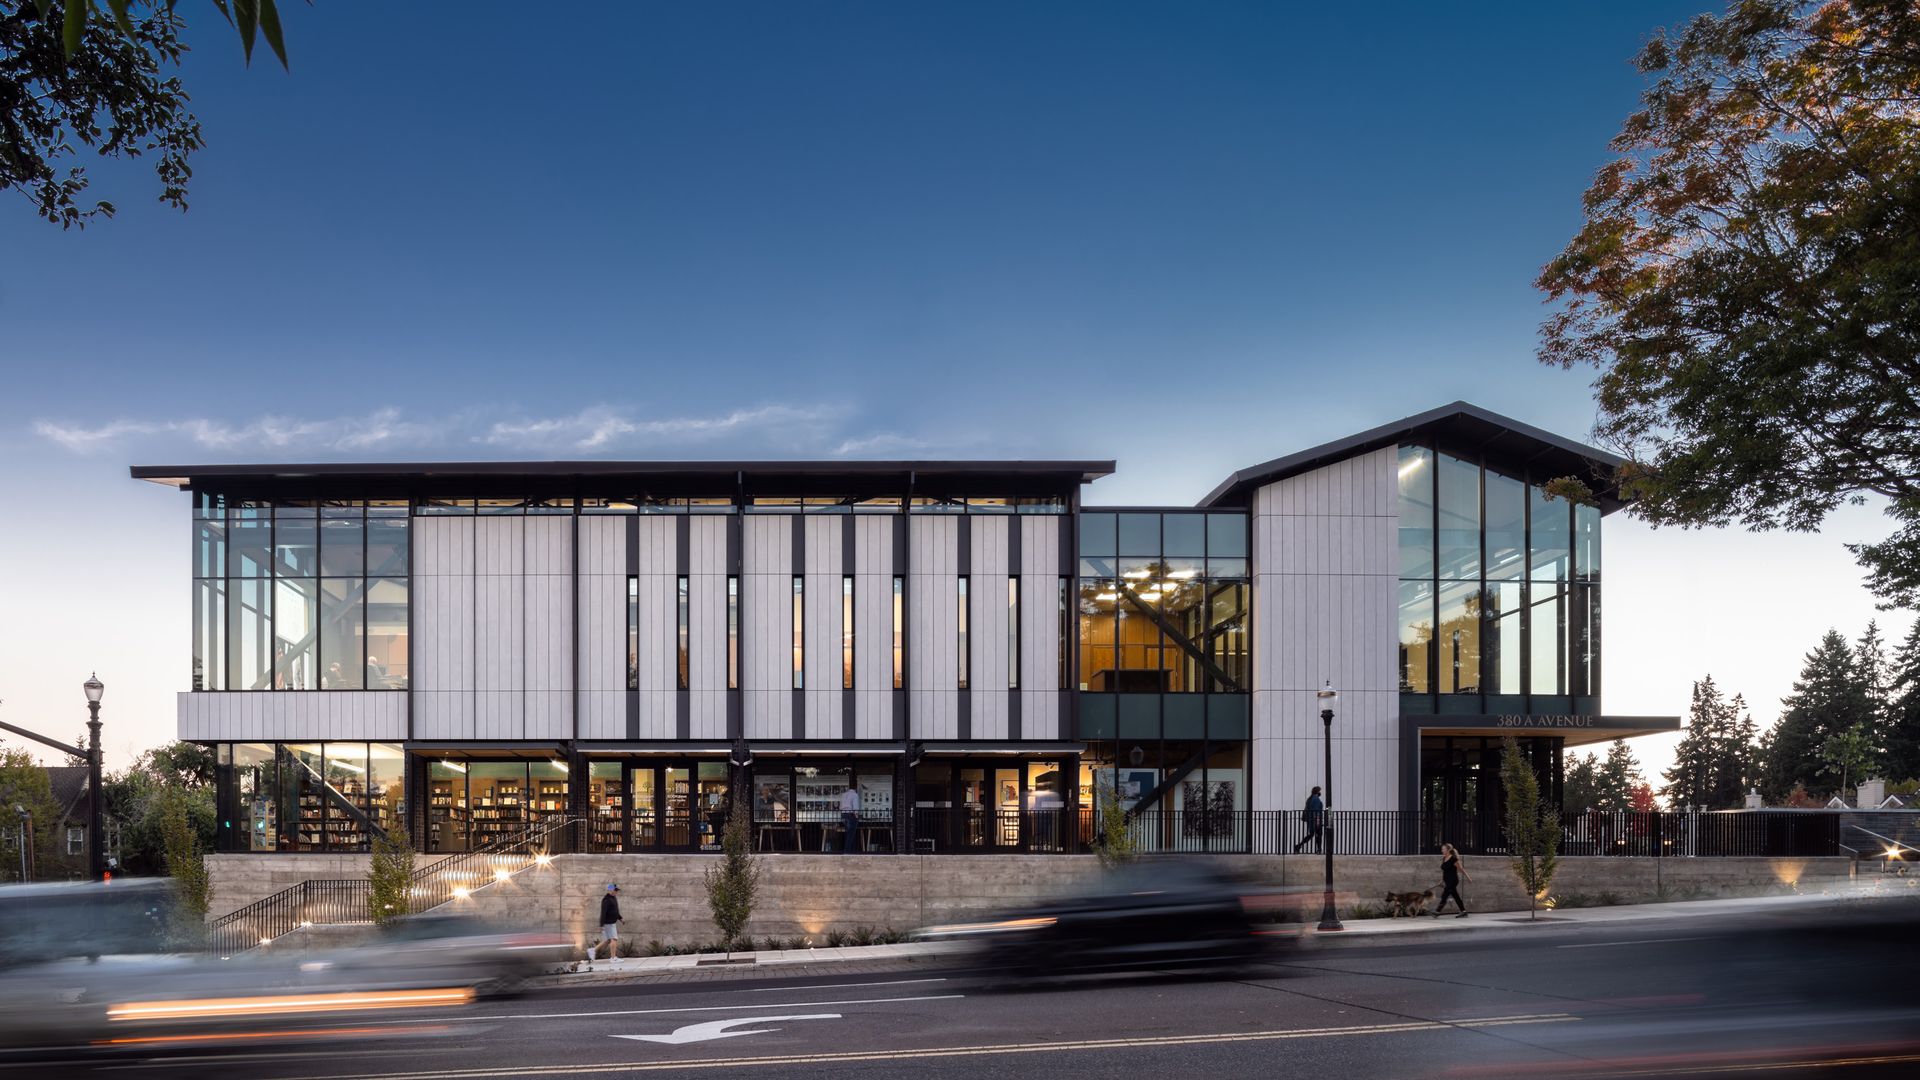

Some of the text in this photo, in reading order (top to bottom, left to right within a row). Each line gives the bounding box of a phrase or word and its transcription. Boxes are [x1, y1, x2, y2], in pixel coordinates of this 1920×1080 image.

[1497, 714, 1593, 727] 380 A AVENUE
